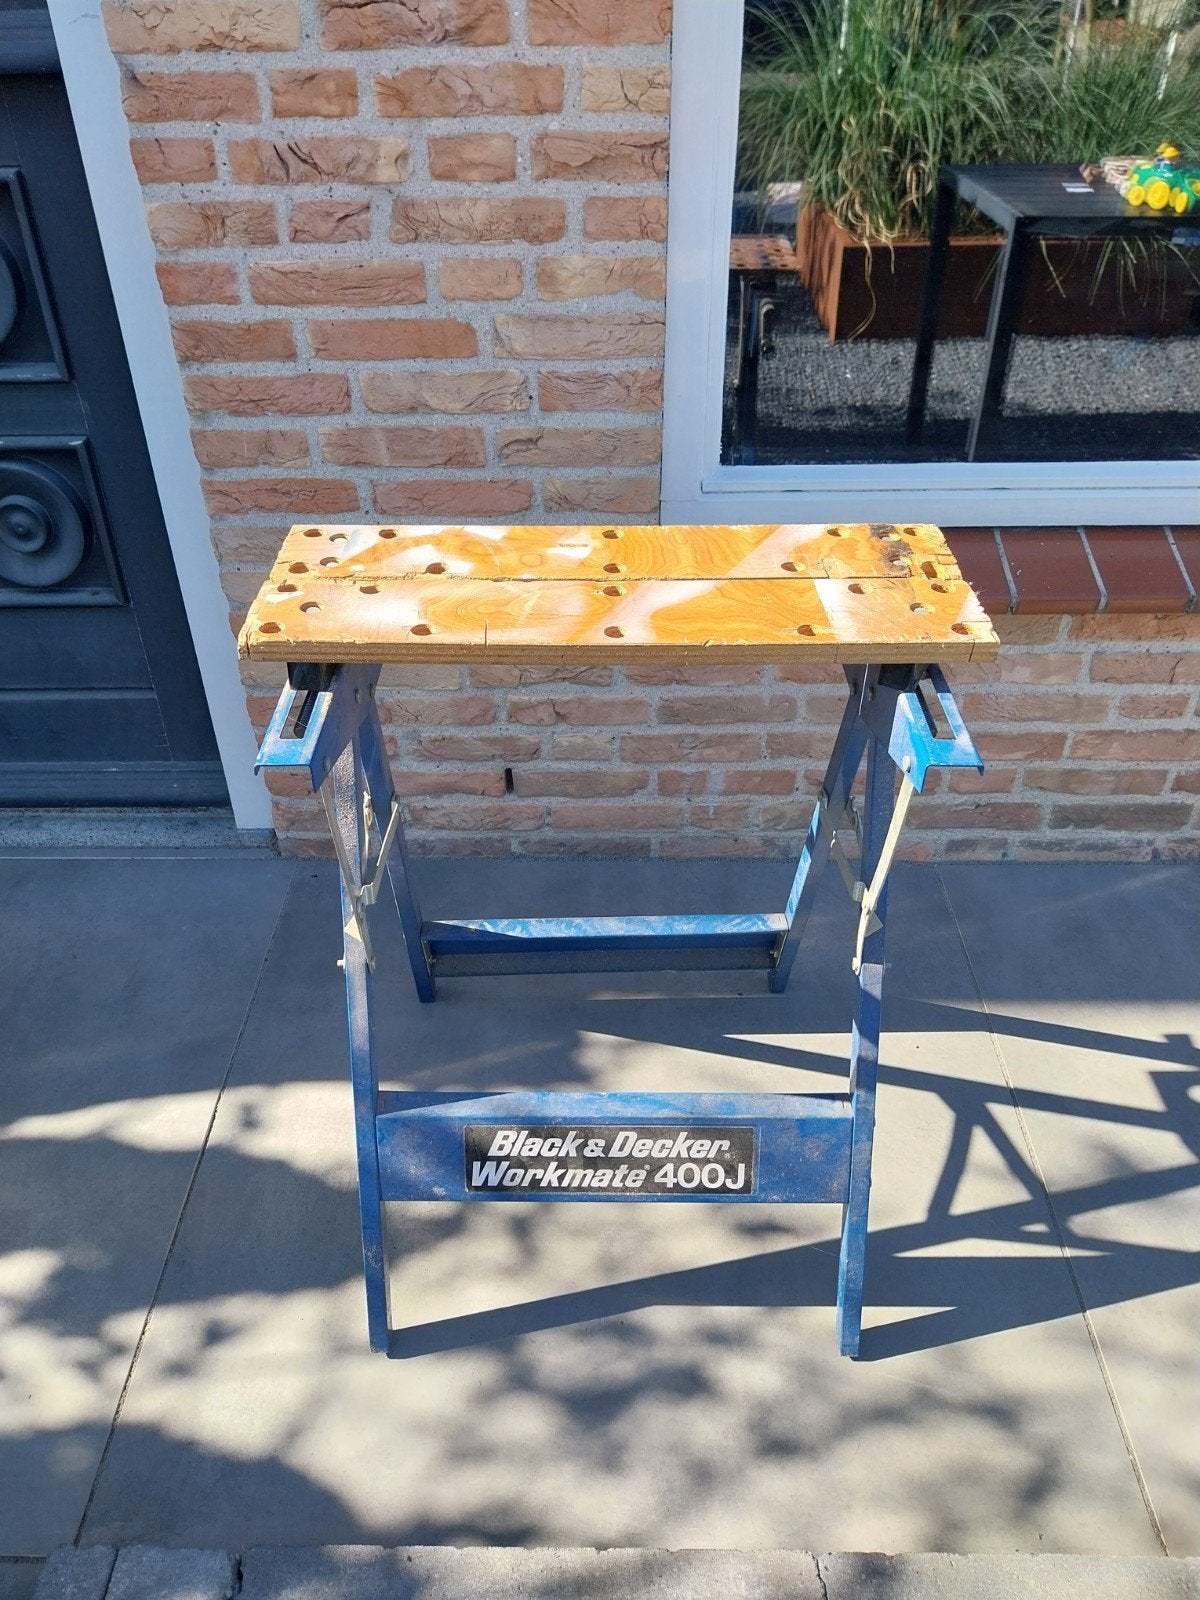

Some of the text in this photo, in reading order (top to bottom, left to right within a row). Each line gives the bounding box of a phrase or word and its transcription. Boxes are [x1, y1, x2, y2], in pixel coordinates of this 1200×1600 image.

[487, 1130, 585, 1158] Black
[607, 1131, 730, 1159] Decker
[471, 1161, 745, 1189] Workmate 400J
